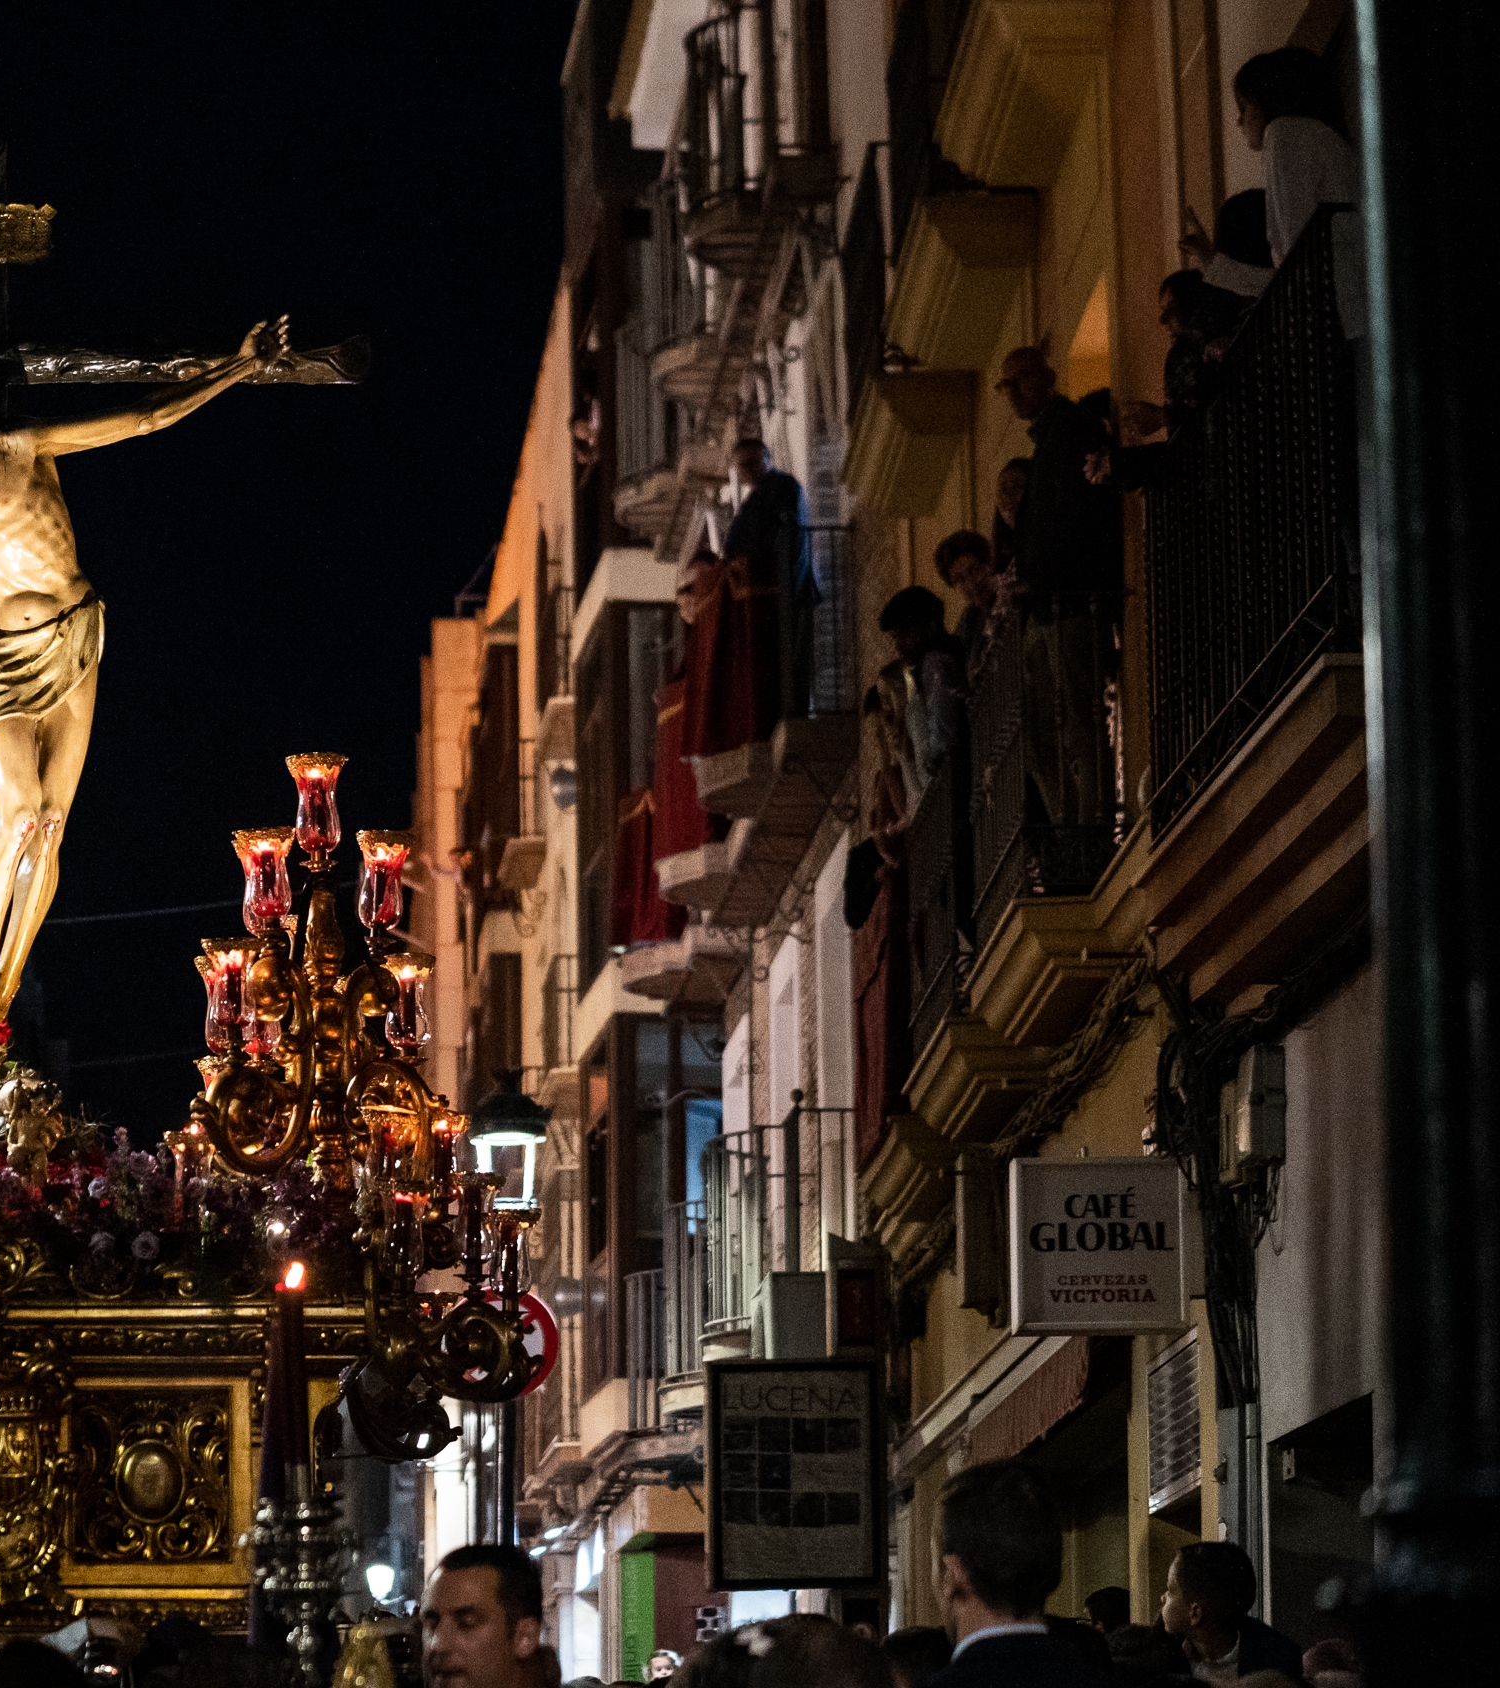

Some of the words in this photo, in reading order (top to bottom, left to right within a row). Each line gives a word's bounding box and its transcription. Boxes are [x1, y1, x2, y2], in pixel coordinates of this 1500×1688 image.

[1064, 1187, 1136, 1219] CAFÉ
[1029, 1221, 1174, 1252] GLOBAL
[1057, 1274, 1149, 1286] CERVEZAS
[1049, 1289, 1156, 1303] VICTORIA
[722, 1385, 862, 1412] LUCENA
